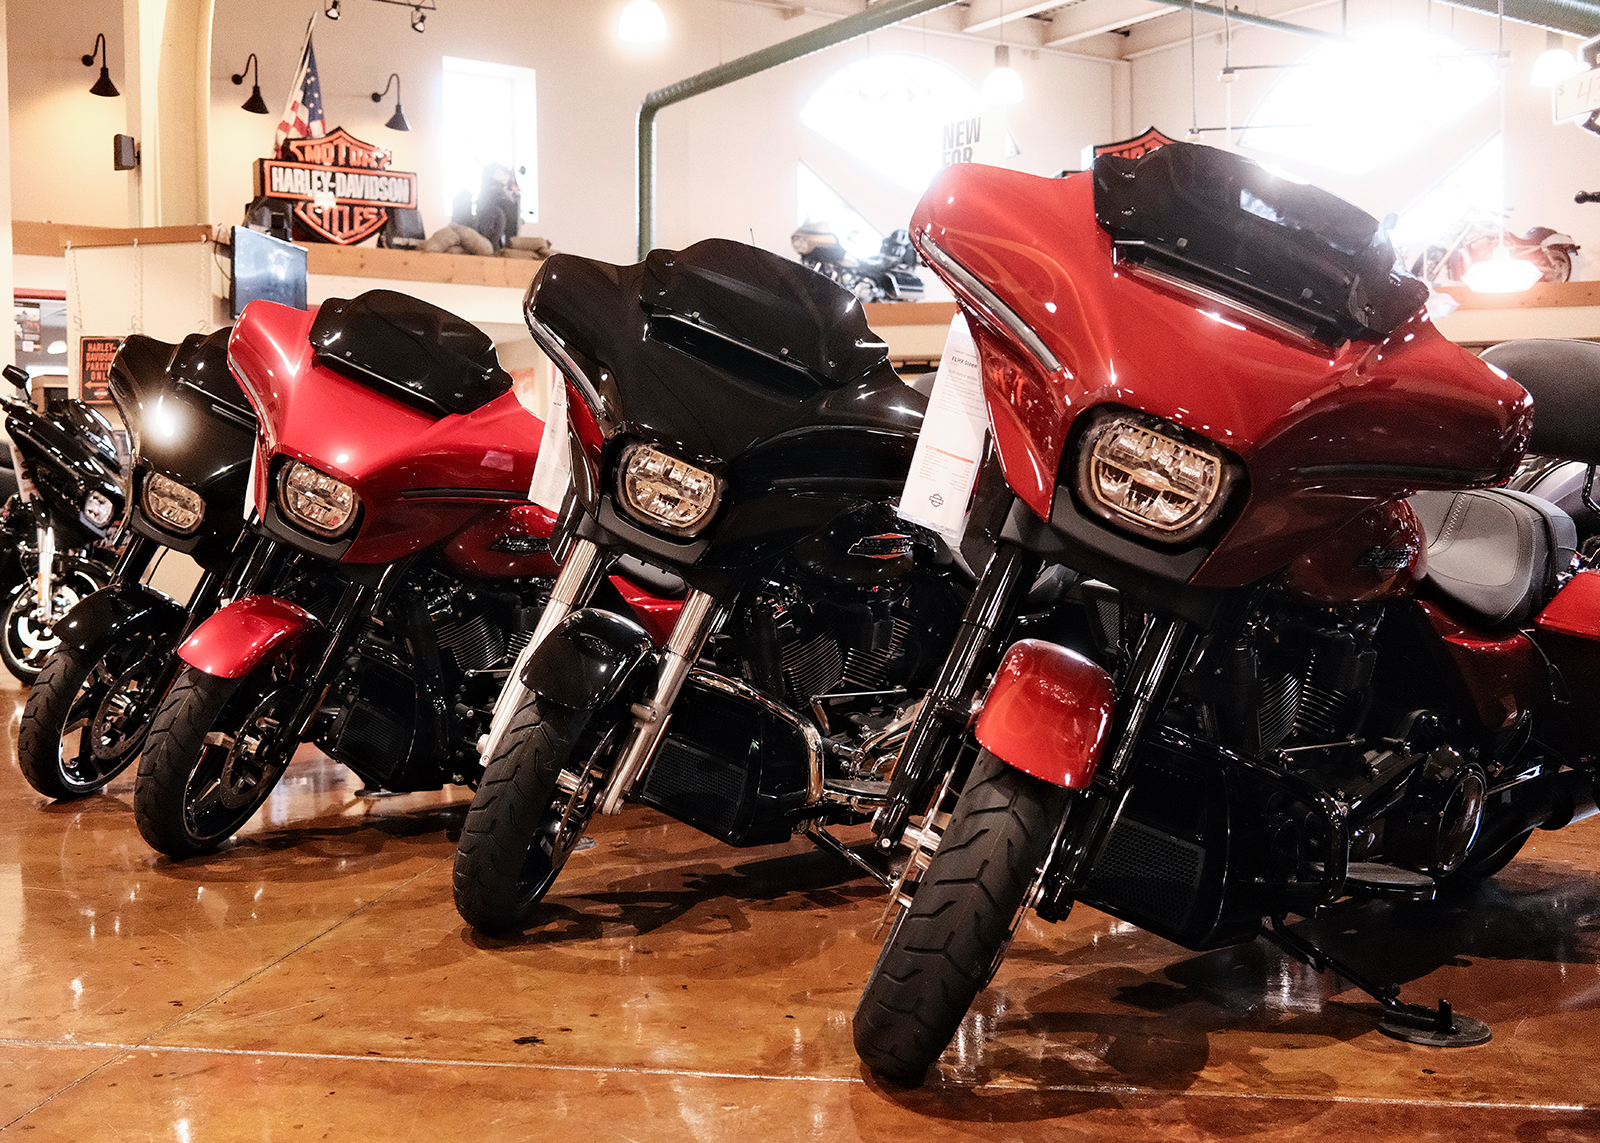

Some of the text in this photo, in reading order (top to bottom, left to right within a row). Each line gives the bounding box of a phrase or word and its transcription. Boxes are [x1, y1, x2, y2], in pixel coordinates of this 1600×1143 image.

[942, 115, 983, 151] NEW
[304, 138, 376, 168] MOTOR
[271, 166, 410, 203] HARLEY-DAVIDSON
[91, 371, 108, 381] ONL
